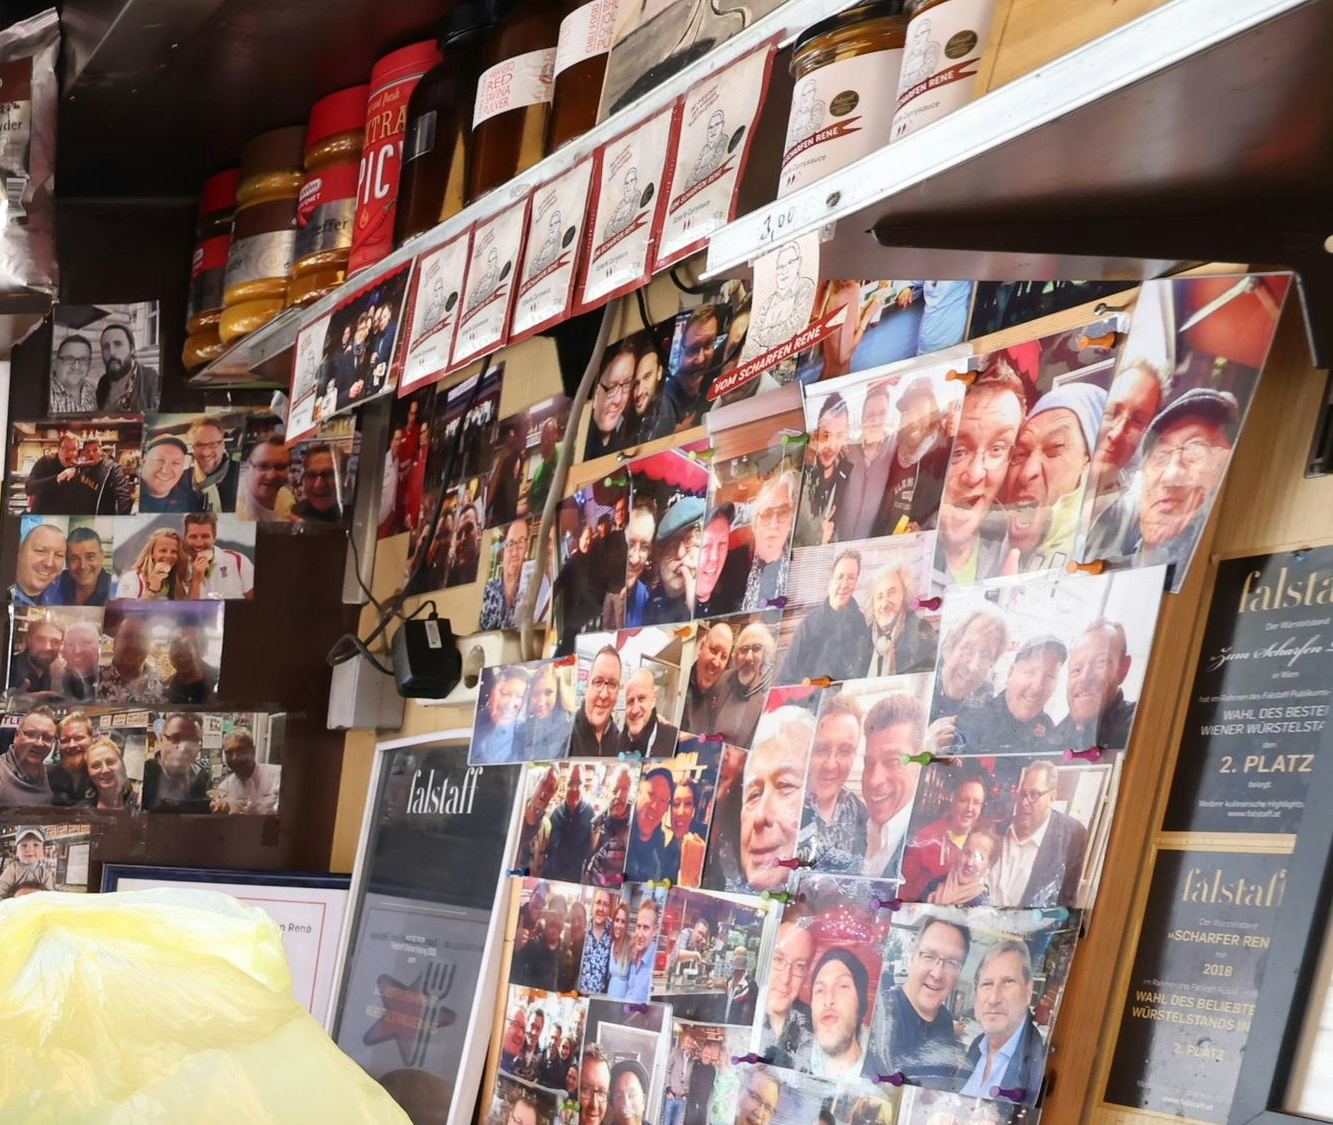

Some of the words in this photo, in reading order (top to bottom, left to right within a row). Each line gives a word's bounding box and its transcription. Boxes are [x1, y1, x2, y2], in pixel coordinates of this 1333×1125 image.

[486, 74, 513, 92] RED
[927, 70, 955, 89] RENE
[815, 126, 840, 143] RENE
[714, 374, 736, 394] VOM
[738, 342, 793, 381] SCHARFEN
[793, 324, 823, 350] RENE
[1223, 708, 1257, 721] WAHL
[1259, 707, 1283, 719] DES
[1200, 723, 1244, 736] WIENER
[1219, 755, 1237, 774] 2.
[1243, 753, 1316, 774] PLATZ
[405, 766, 483, 816] falstaff
[1203, 963, 1234, 978] 2018
[1135, 991, 1167, 1006] WAHL
[1171, 995, 1196, 1009] DES
[1133, 1005, 1235, 1031] WÜRSTELSTANDS
[1237, 1021, 1252, 1034] IN
